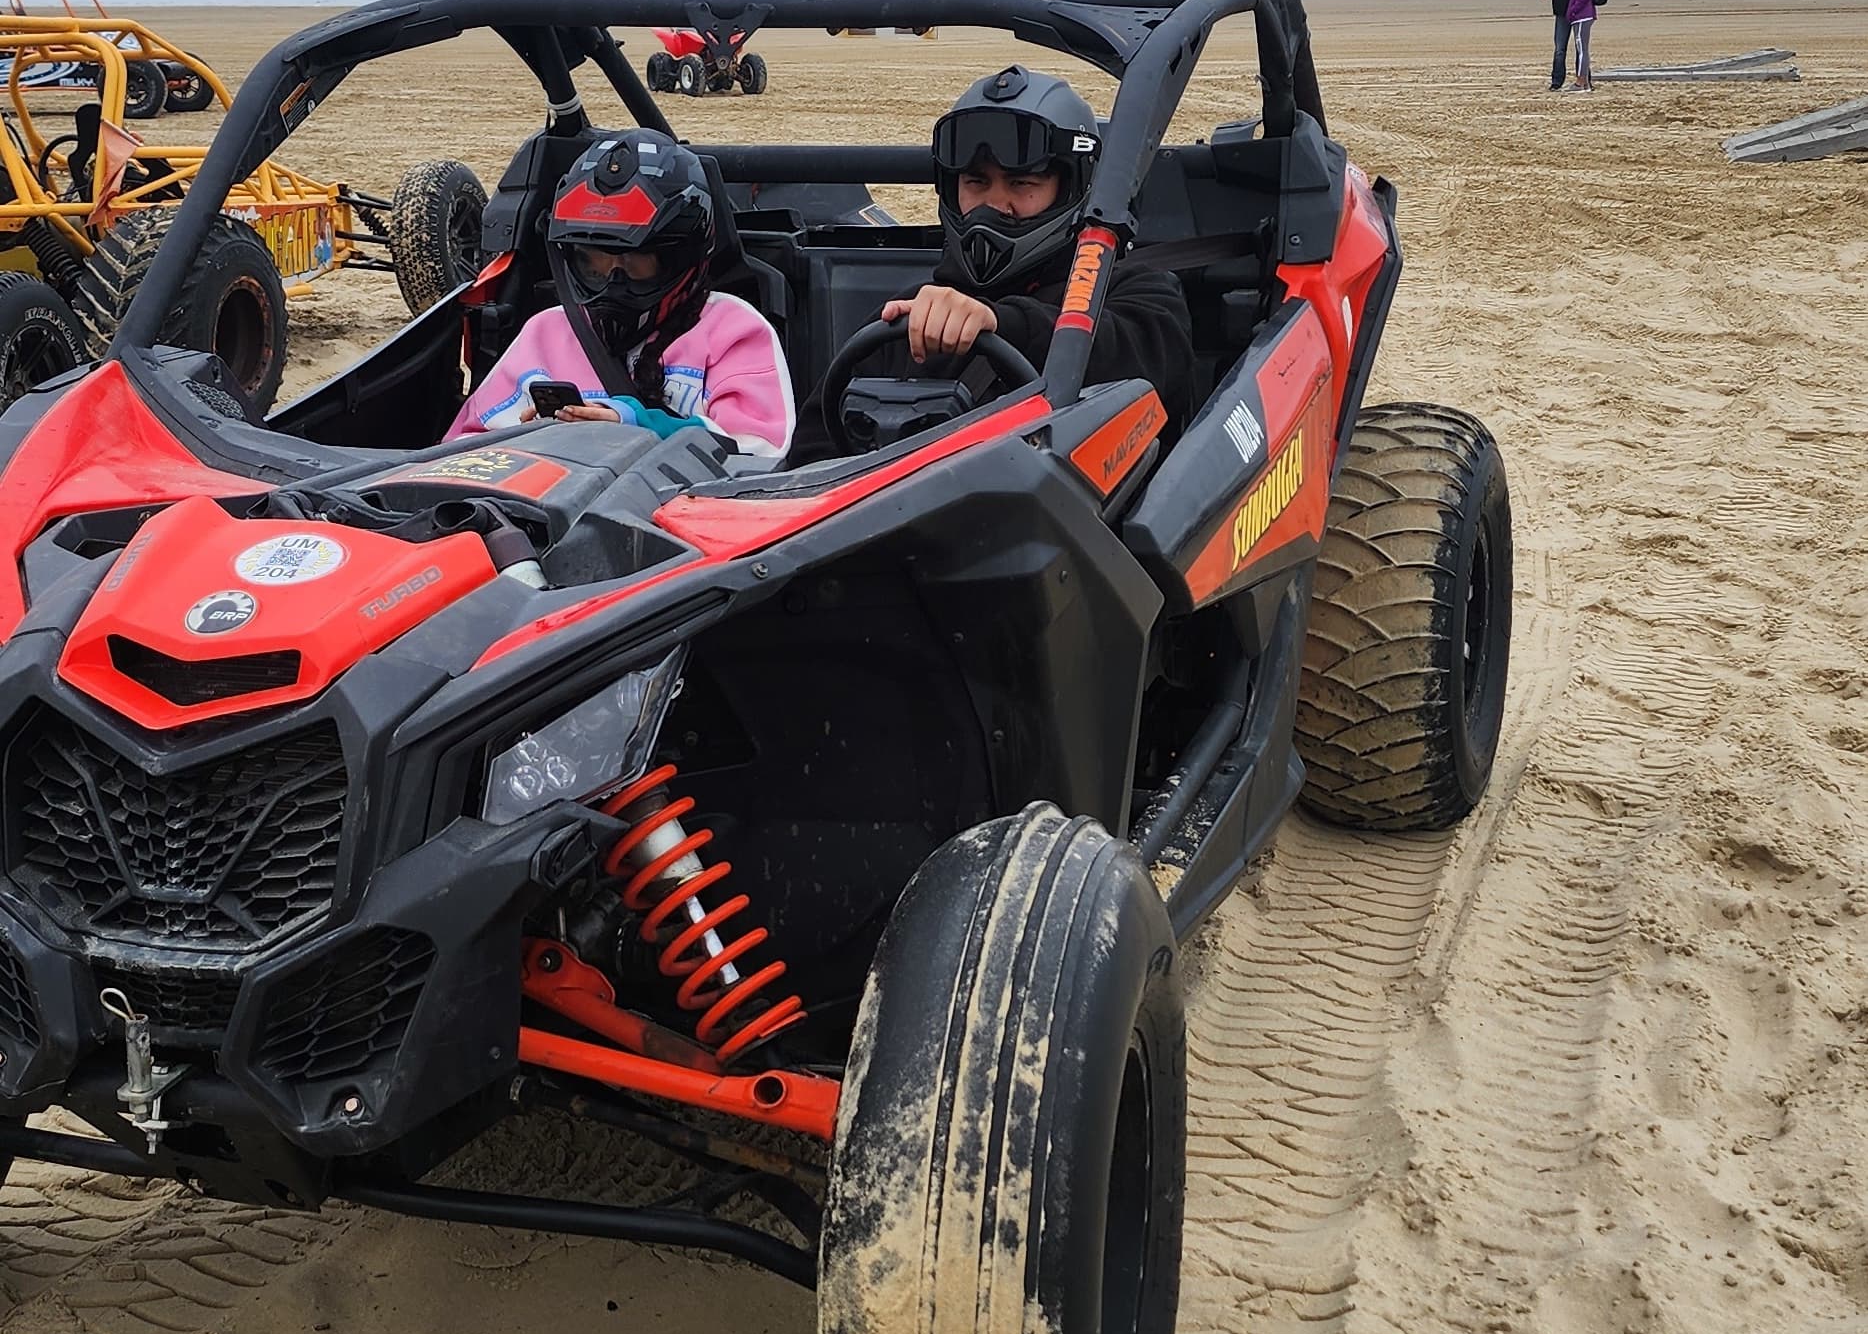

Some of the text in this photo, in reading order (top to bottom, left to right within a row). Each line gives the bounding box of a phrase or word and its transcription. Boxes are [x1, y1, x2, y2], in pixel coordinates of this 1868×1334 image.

[1102, 401, 1158, 480] MAVERICK
[1231, 427, 1304, 572] SUNBUGGY
[280, 537, 321, 550] UM
[253, 566, 298, 579] 204
[358, 565, 443, 620] TURBO
[208, 610, 249, 622] BRP
